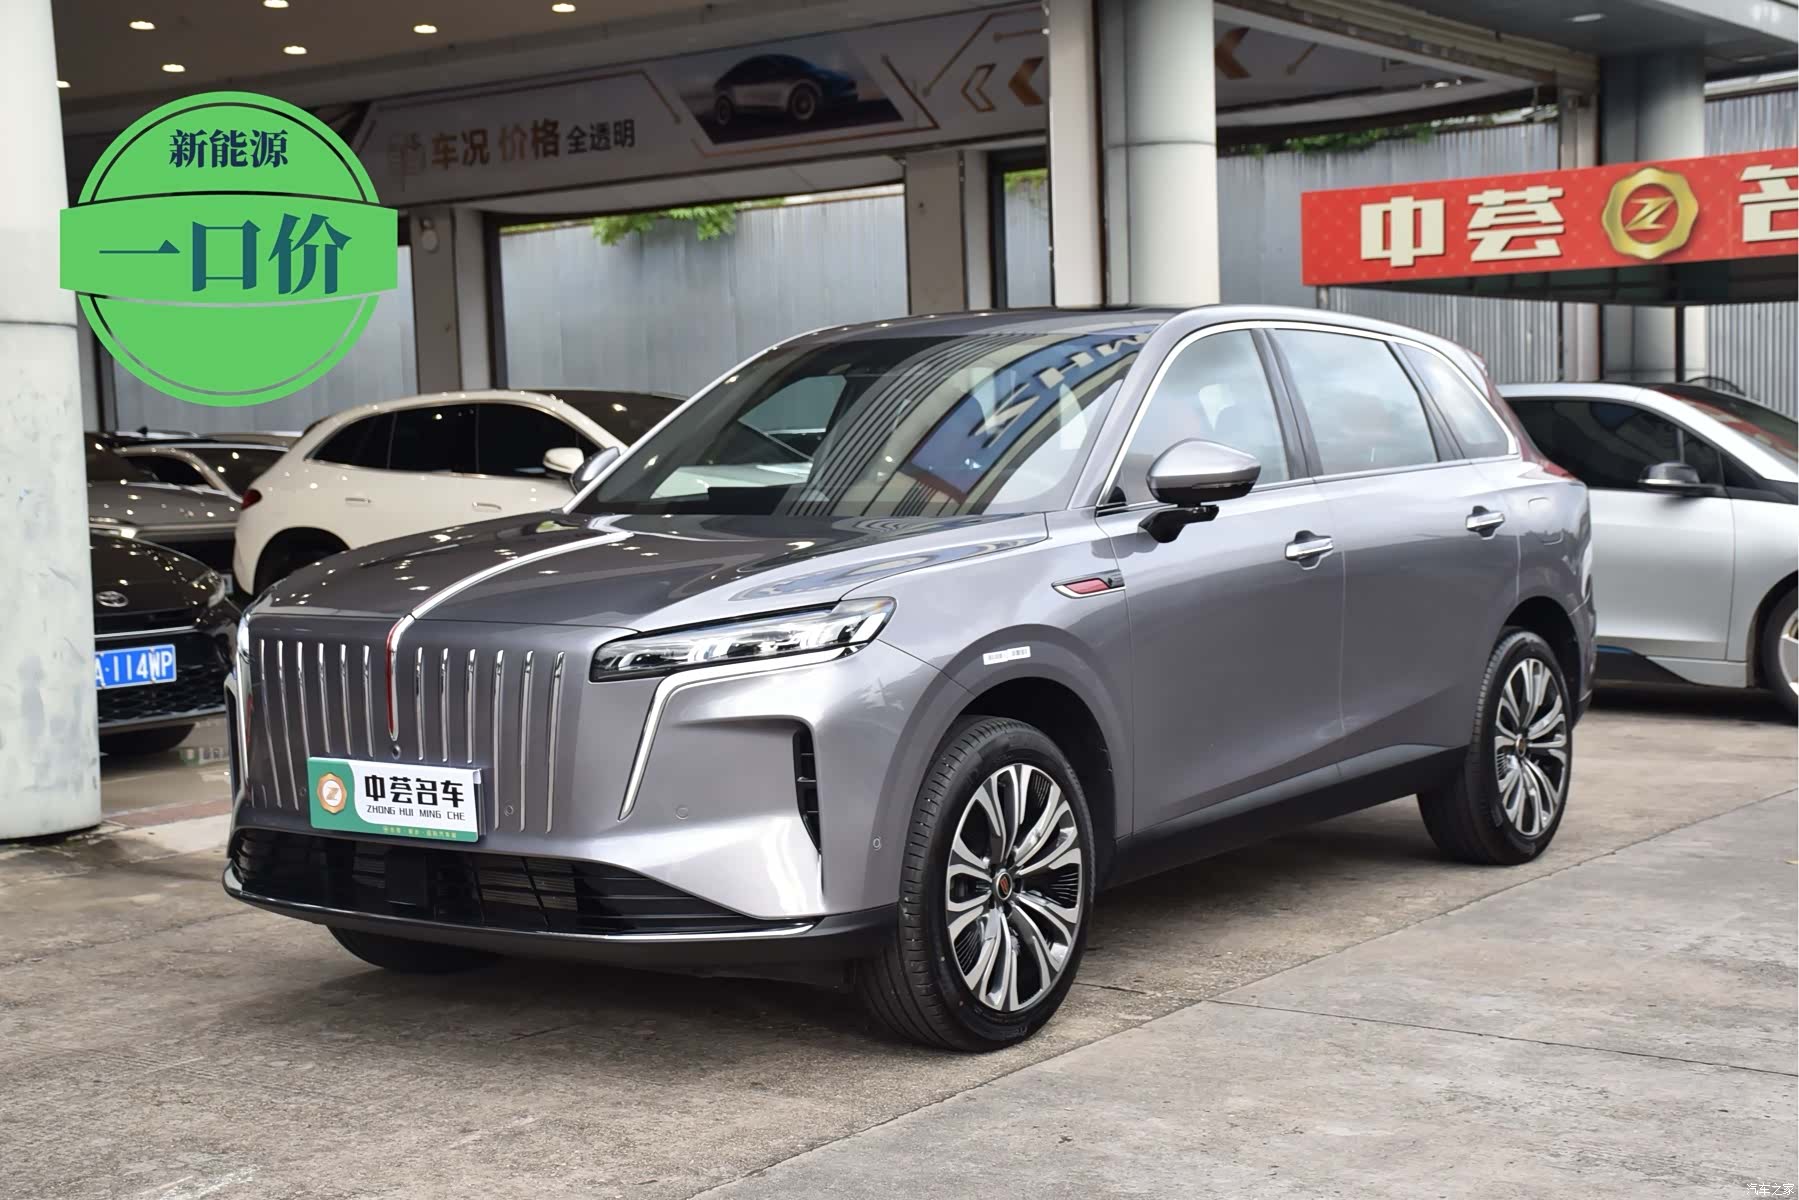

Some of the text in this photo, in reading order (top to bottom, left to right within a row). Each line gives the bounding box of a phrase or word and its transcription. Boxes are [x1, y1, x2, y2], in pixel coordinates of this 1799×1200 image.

[432, 118, 636, 170] 车况 价格 全透明
[1360, 186, 1565, 267] 中荟
[364, 774, 464, 808] 中荟名车
[366, 805, 466, 821] ZHONG HUI MING CHE
